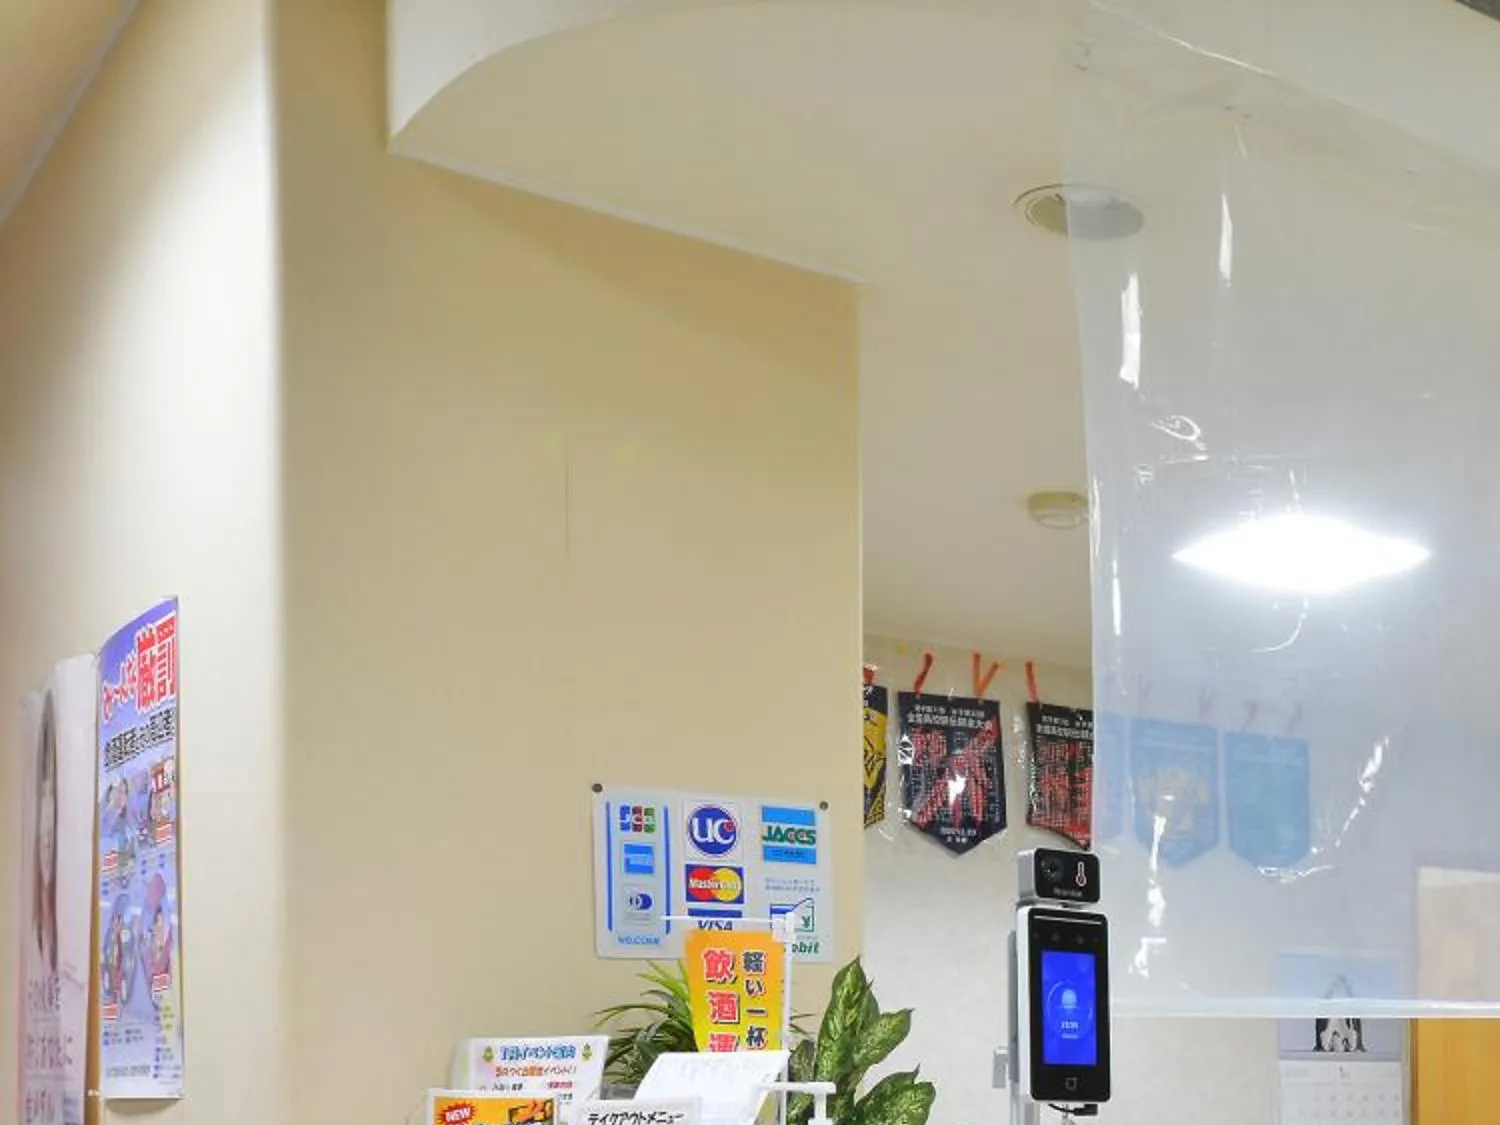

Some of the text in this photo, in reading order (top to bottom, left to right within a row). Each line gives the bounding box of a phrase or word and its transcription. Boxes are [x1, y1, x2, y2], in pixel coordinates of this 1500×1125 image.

[692, 817, 736, 845] UC
[761, 826, 817, 845] JACCS
[698, 919, 733, 930] VISA
[446, 1107, 471, 1122] NEW
